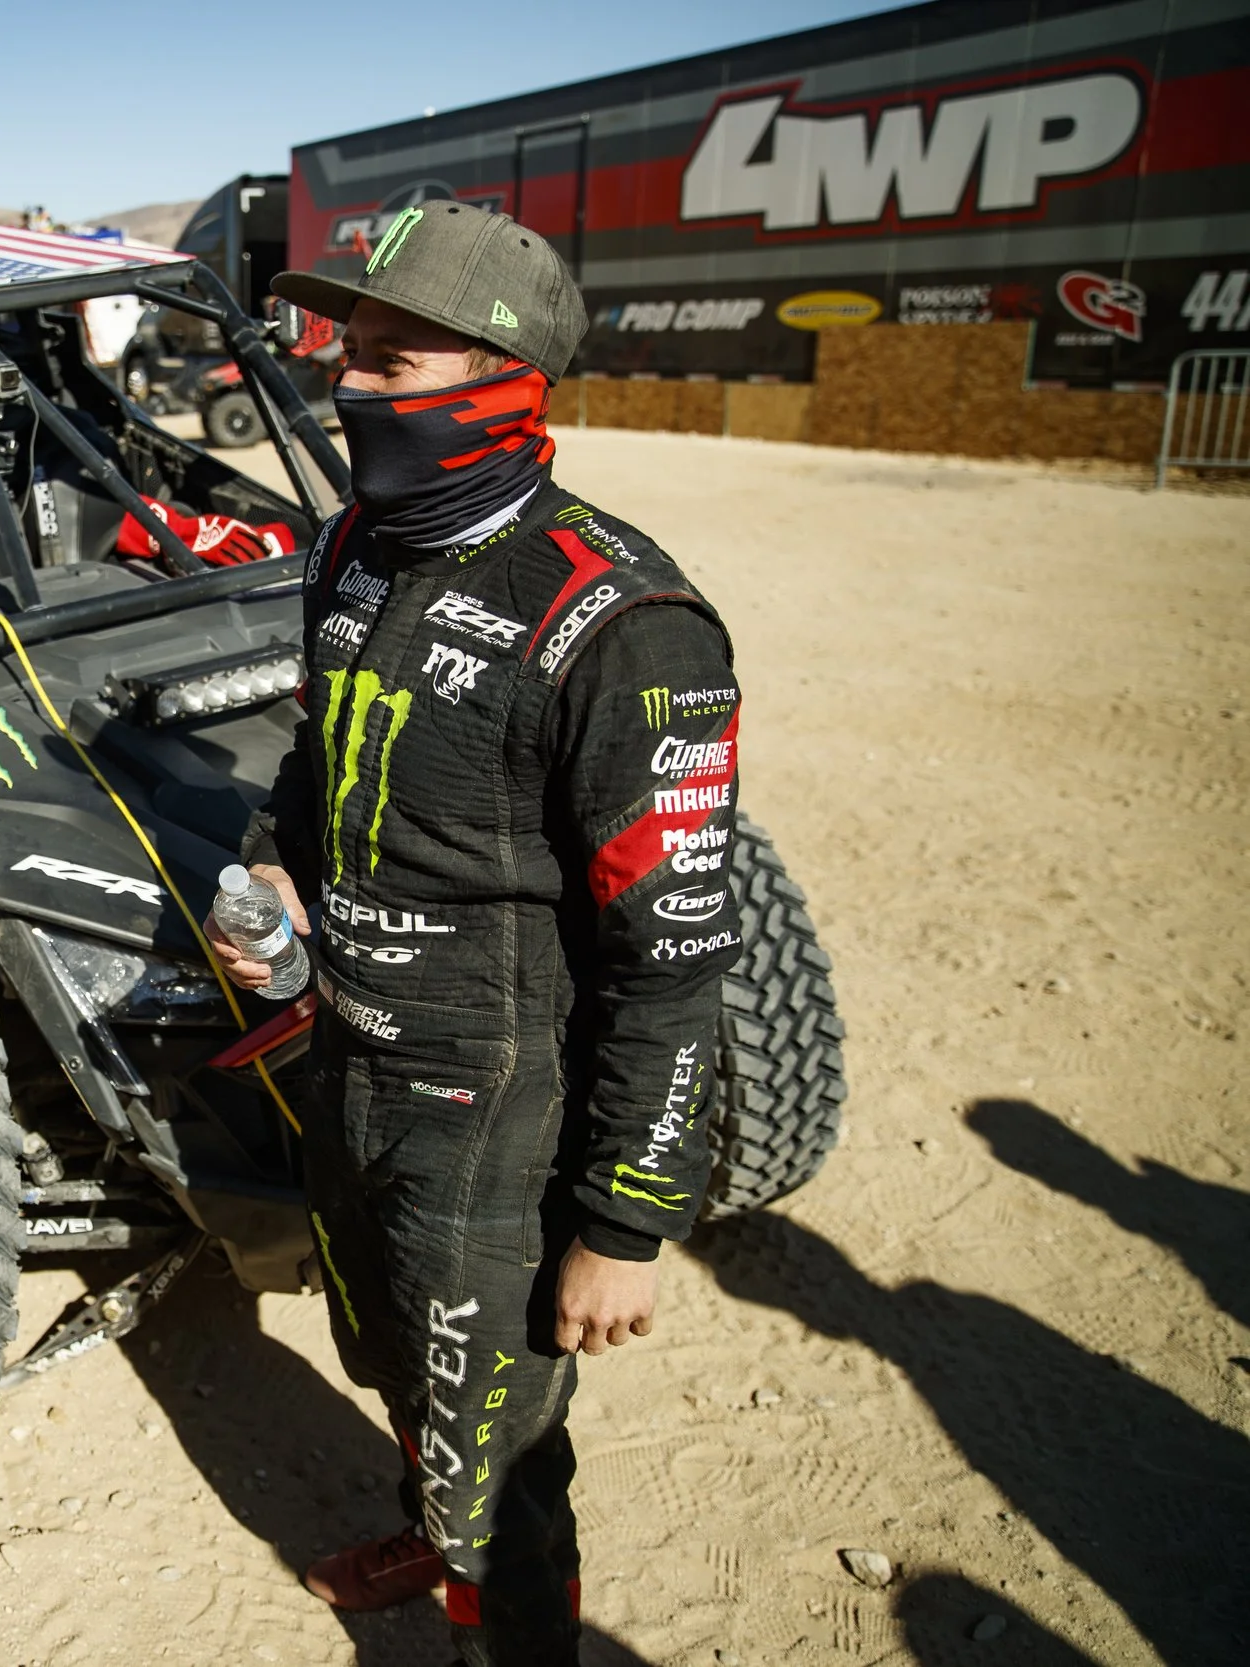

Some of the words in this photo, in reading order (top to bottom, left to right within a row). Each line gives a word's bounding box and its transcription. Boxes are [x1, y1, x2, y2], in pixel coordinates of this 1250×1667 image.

[680, 73, 1141, 231] 4WP
[617, 300, 676, 332] PRO
[673, 298, 765, 331] COMP
[459, 525, 516, 564] ENERGY
[336, 559, 390, 605] CURRIE
[444, 590, 484, 608] POLARIS
[423, 614, 474, 635] FACTORY
[471, 631, 514, 649] RACING
[424, 596, 528, 640] RZR
[539, 584, 622, 674] sparco
[318, 630, 360, 654] WHEELS
[421, 641, 490, 706] FOX
[672, 688, 736, 707] MONSTER
[683, 704, 731, 718] ENERGY
[650, 735, 733, 775] CURRIE
[669, 765, 728, 780] ENTERPRISES
[654, 783, 730, 815] MAHLE
[10, 854, 168, 906] RZR
[671, 850, 725, 874] Gear
[666, 890, 724, 912] Torco
[337, 1005, 402, 1041] CURRIE
[639, 1039, 697, 1169] MOSTER
[467, 1350, 516, 1549] ENERGY
